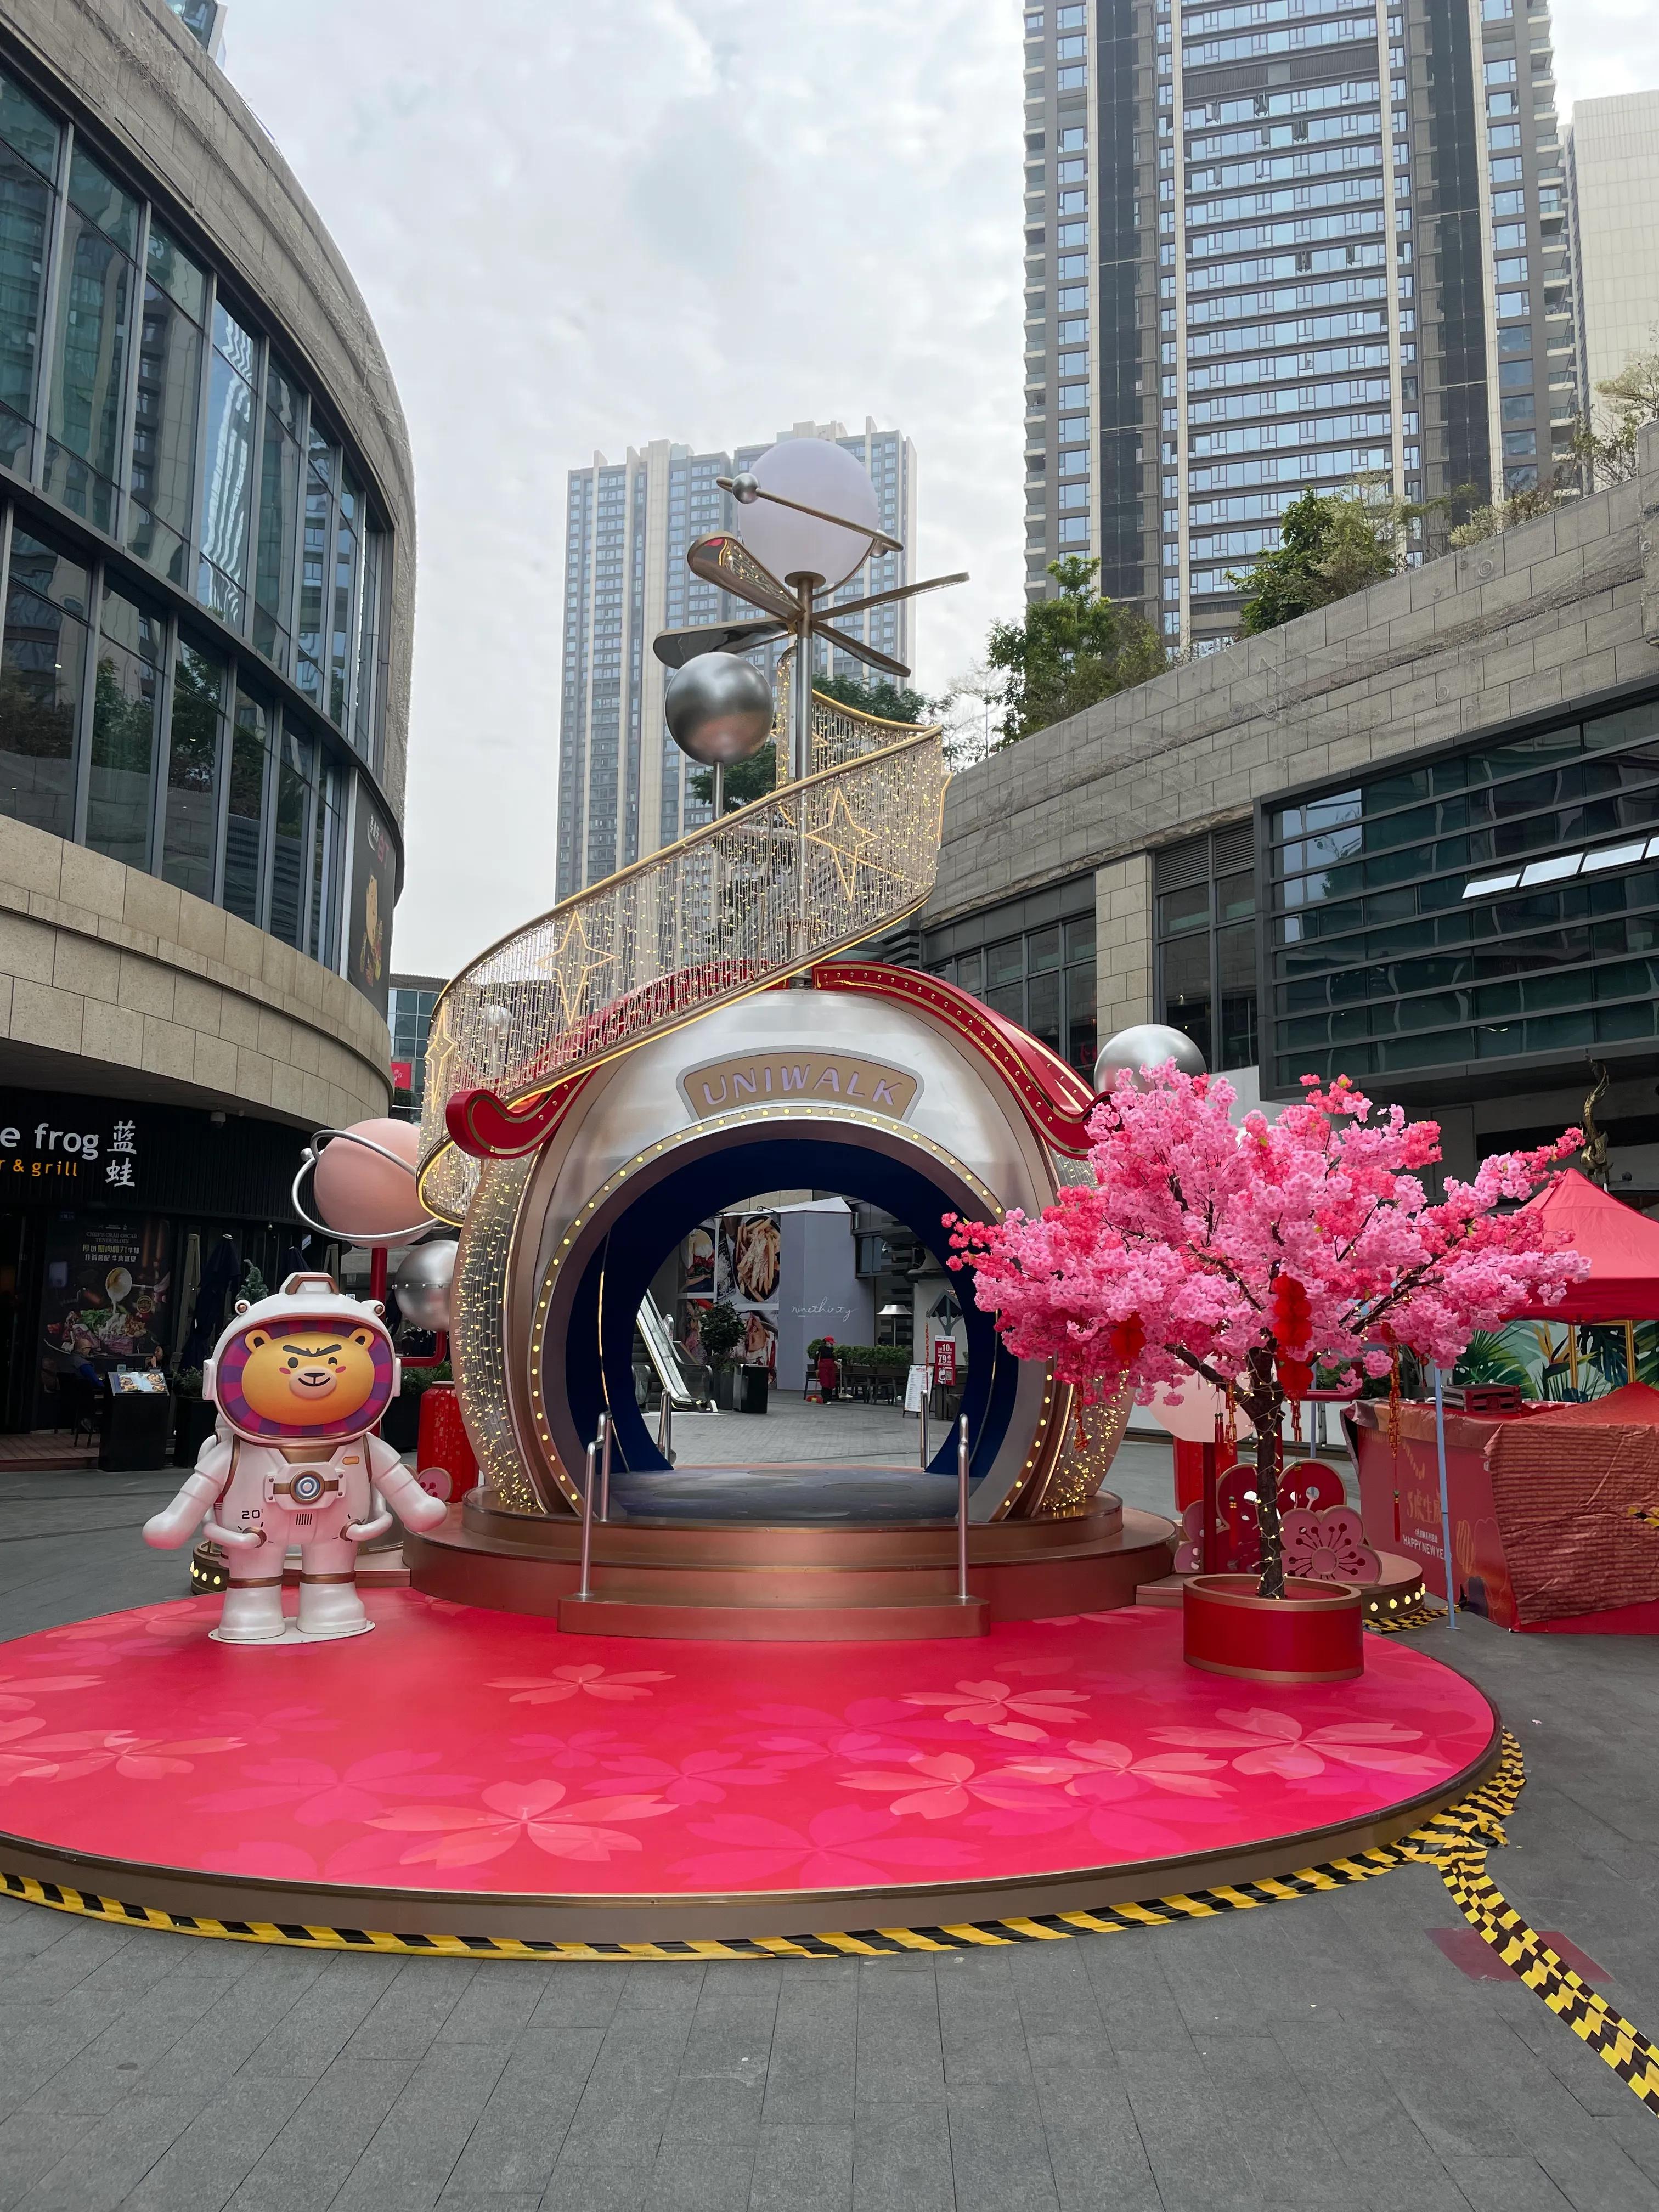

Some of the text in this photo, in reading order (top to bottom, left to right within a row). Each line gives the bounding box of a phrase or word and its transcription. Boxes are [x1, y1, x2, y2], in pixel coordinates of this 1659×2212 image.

[702, 1064, 904, 1105] UNIWALK
[34, 1123, 100, 1160] frog
[105, 1120, 137, 1187] 蓝蛙
[13, 1159, 25, 1172] &
[31, 1161, 77, 1177] grill
[1403, 1534, 1421, 1552] HAPPY
[1421, 1542, 1435, 1556] NEW
